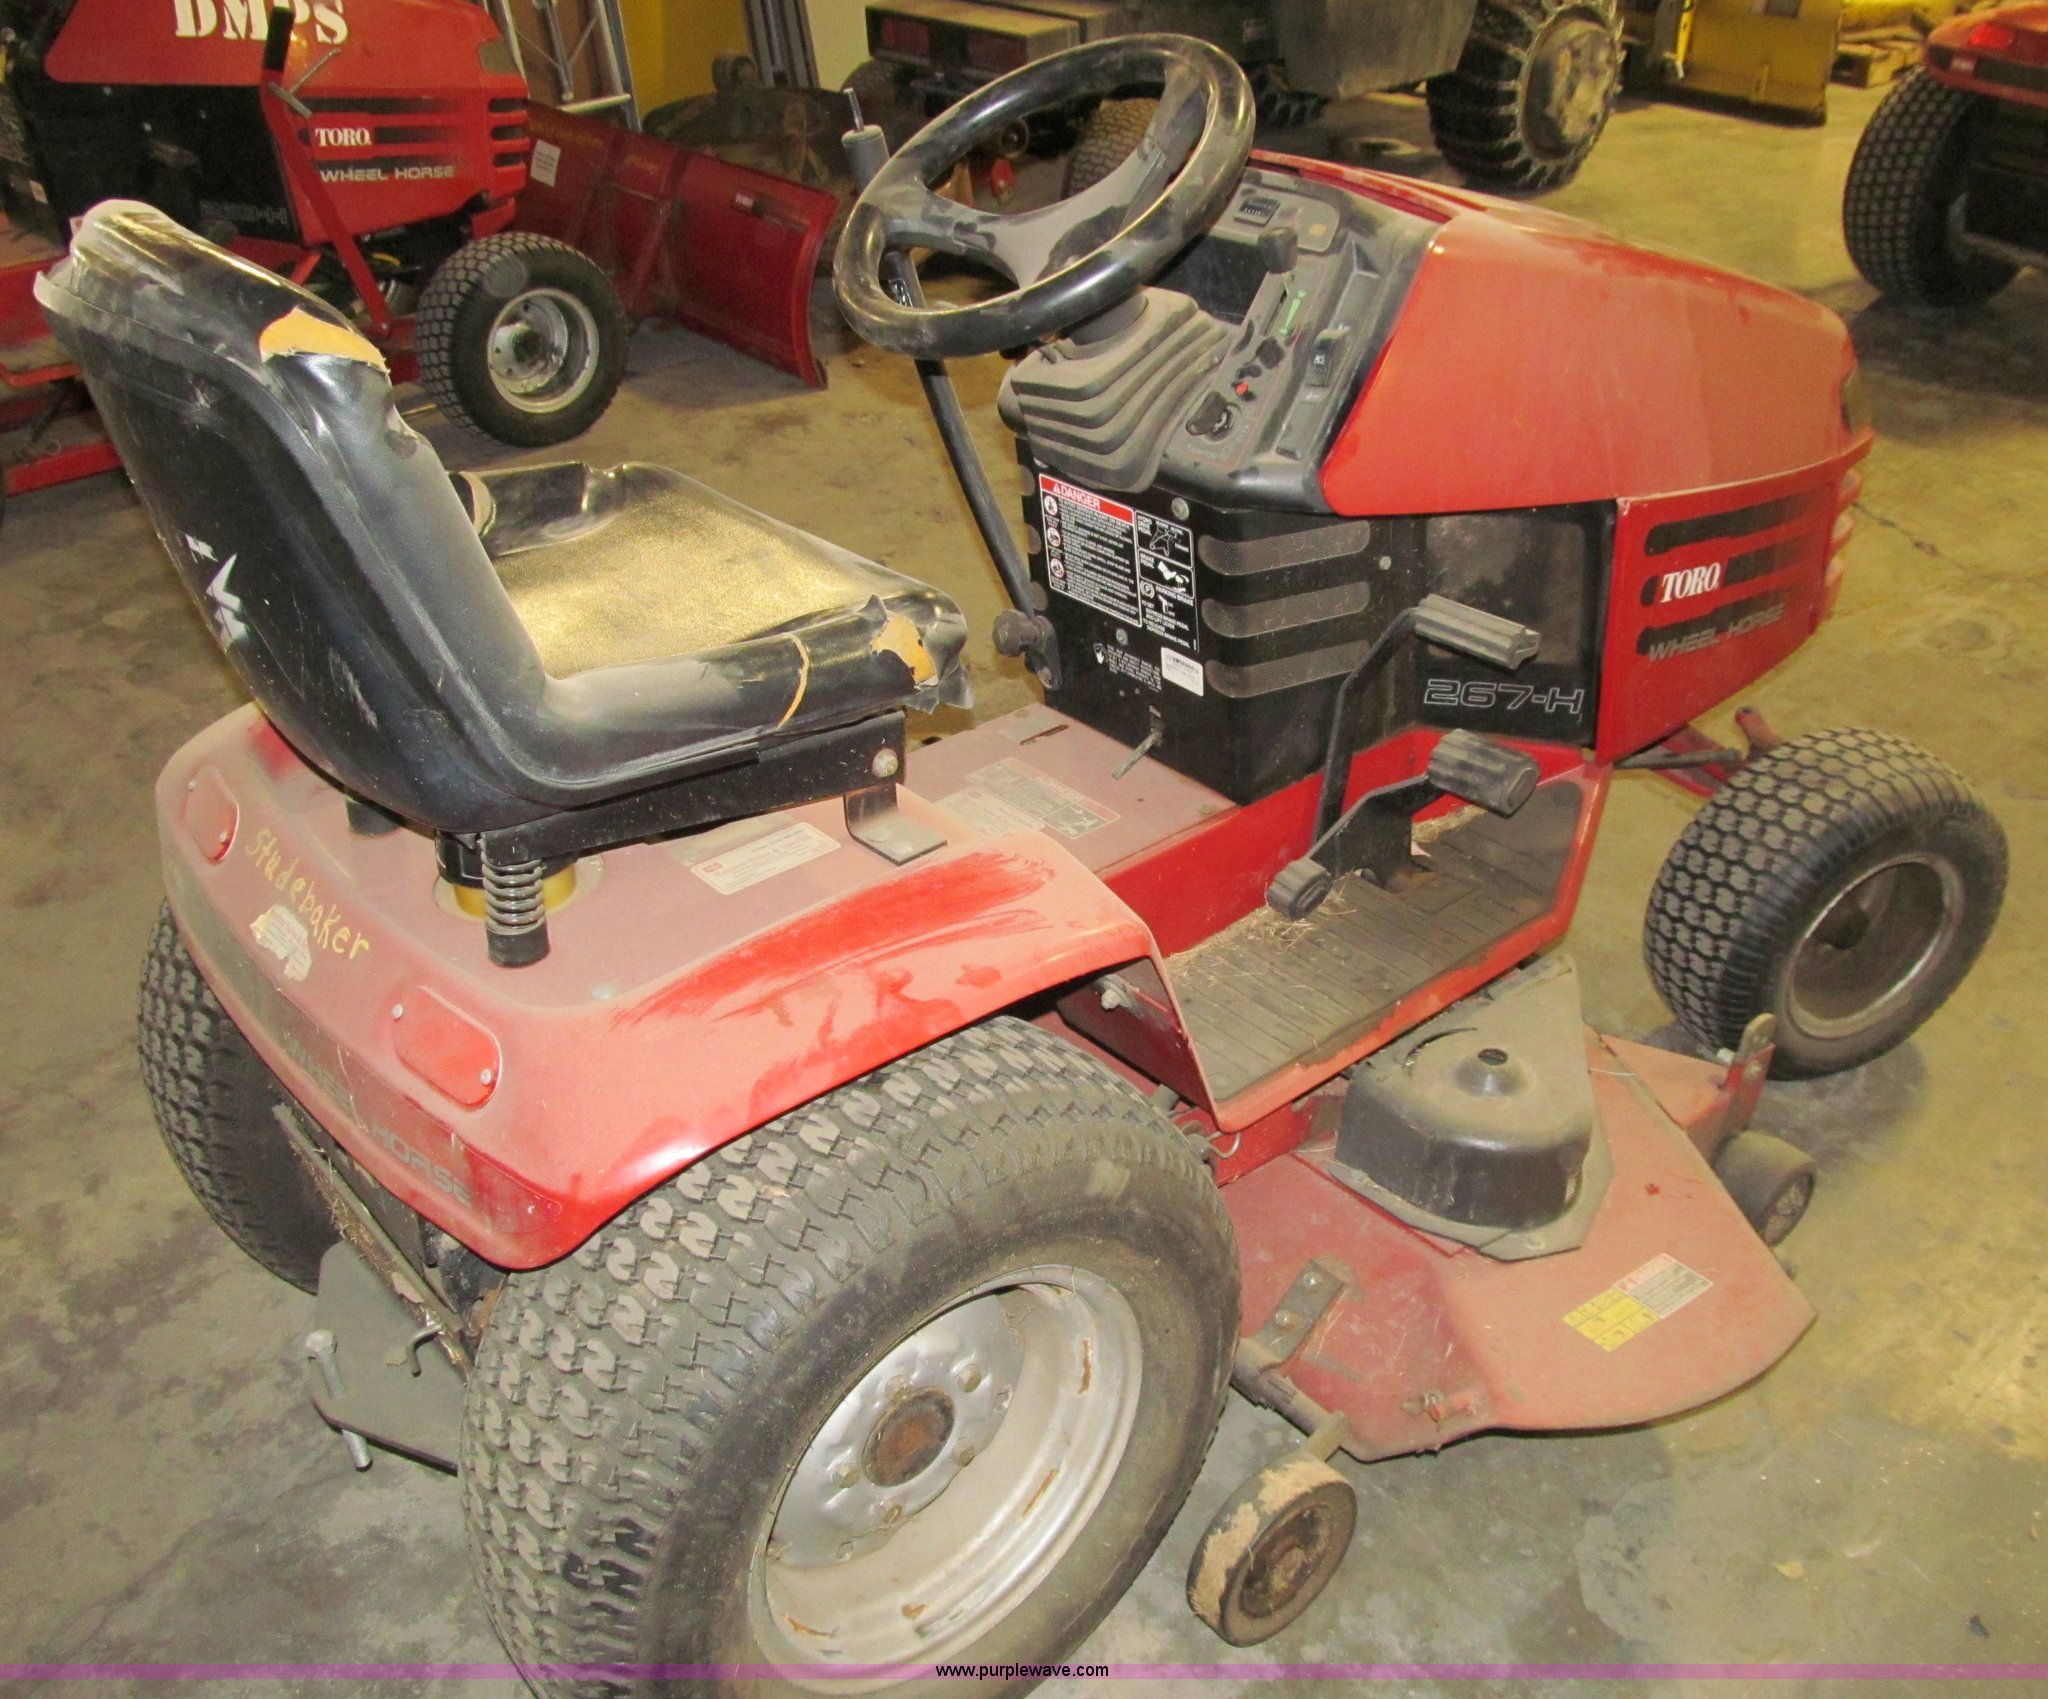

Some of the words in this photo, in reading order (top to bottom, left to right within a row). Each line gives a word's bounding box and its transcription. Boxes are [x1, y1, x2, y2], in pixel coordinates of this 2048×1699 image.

[315, 128, 372, 147] TORO
[319, 168, 388, 183] WHEEL
[394, 165, 456, 180] HORSE
[1061, 485, 1101, 510] DANGER
[1155, 585, 1177, 599] PARKING
[1177, 594, 1194, 606] BRAKE
[1660, 562, 1720, 603] TORO
[1649, 626, 1720, 662] WHEEL
[1727, 602, 1787, 639] HORSE
[1423, 678, 1584, 714] 267-H
[245, 829, 370, 959] Studebaker
